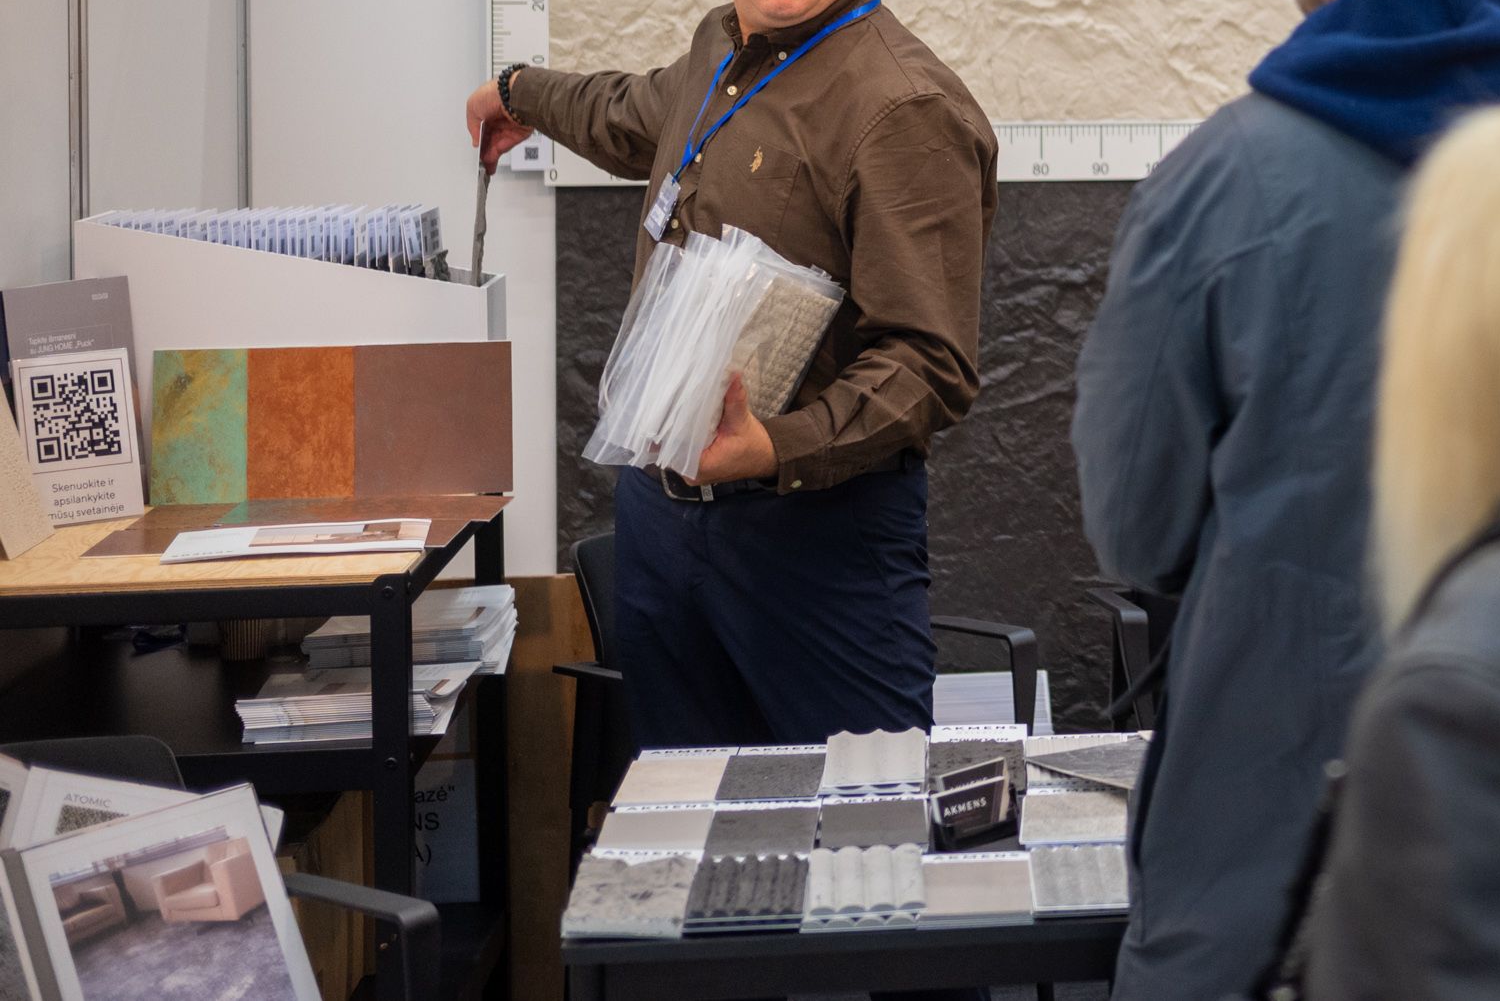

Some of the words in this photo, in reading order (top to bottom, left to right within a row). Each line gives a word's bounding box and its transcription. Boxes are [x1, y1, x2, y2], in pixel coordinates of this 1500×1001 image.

[550, 168, 558, 181] 0
[1032, 162, 1050, 176] 80
[1092, 162, 1110, 176] 90
[52, 478, 106, 493] Skenuokite
[108, 478, 114, 486] ir
[54, 491, 116, 507] apsilankykite
[64, 793, 112, 808] ATOMIC
[944, 797, 987, 818] AKMENS
